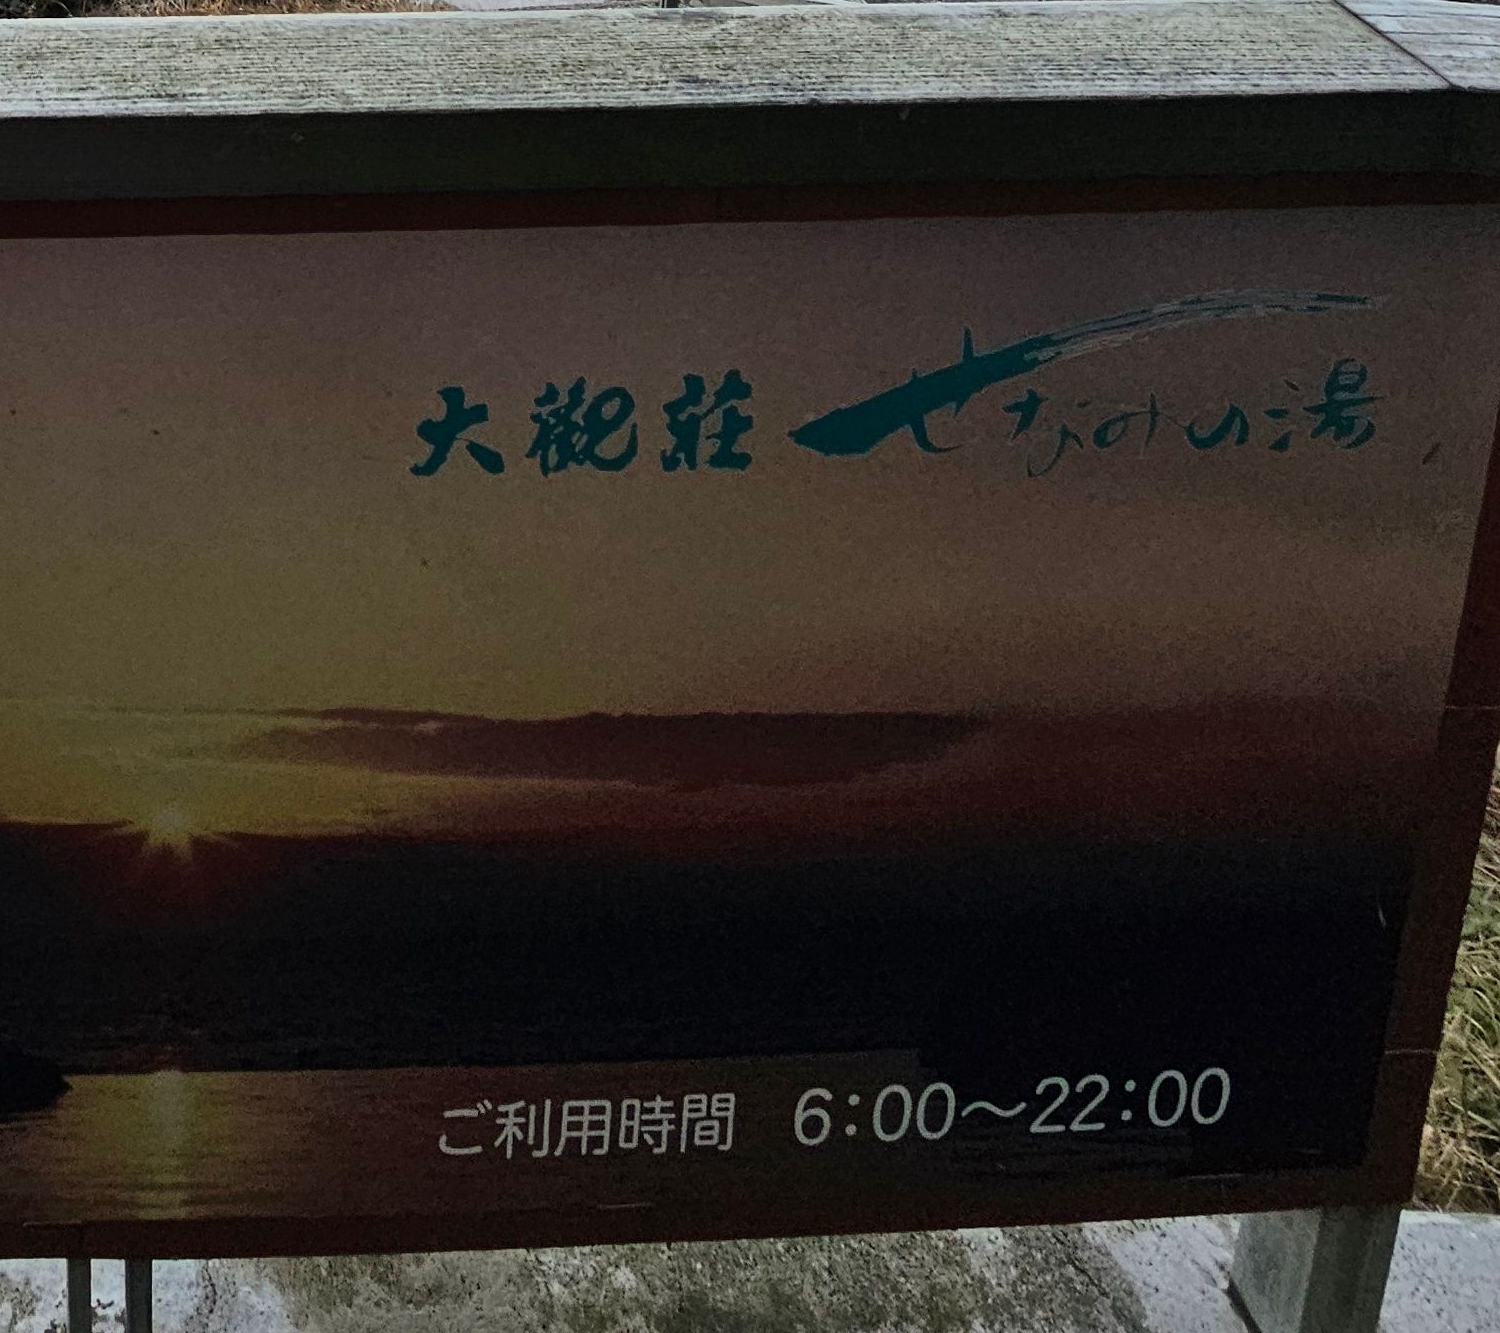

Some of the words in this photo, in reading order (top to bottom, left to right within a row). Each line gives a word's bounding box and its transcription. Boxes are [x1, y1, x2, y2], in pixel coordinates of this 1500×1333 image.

[438, 1092, 735, 1160] ご利用時間
